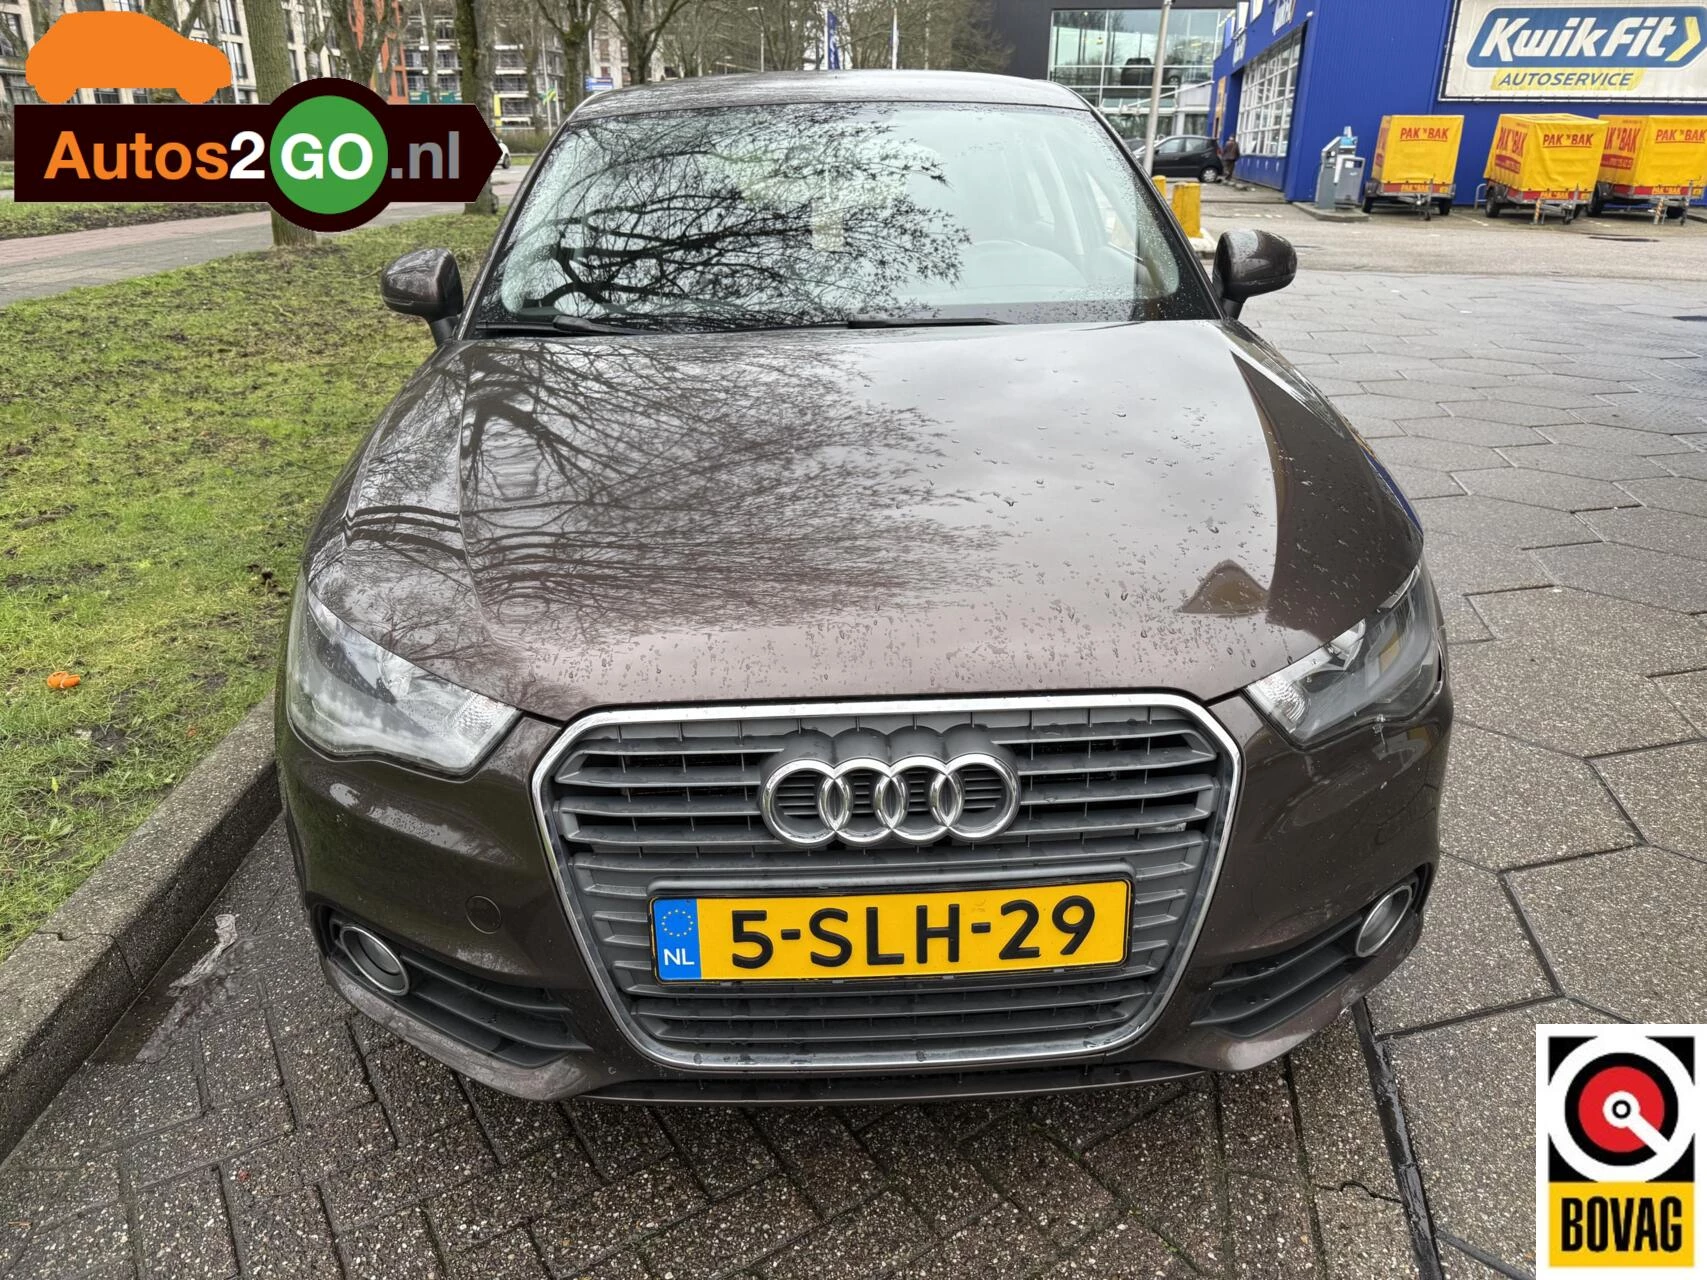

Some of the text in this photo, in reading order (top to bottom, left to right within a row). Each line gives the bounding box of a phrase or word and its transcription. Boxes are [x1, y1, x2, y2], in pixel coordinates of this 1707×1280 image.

[1499, 72, 1634, 87] AUTOSERVICE
[1400, 127, 1421, 139] PAK
[1542, 134, 1564, 146] PAK
[1655, 128, 1677, 141] PAK
[730, 895, 1096, 970] 5-SLH-29
[663, 947, 695, 967] NL
